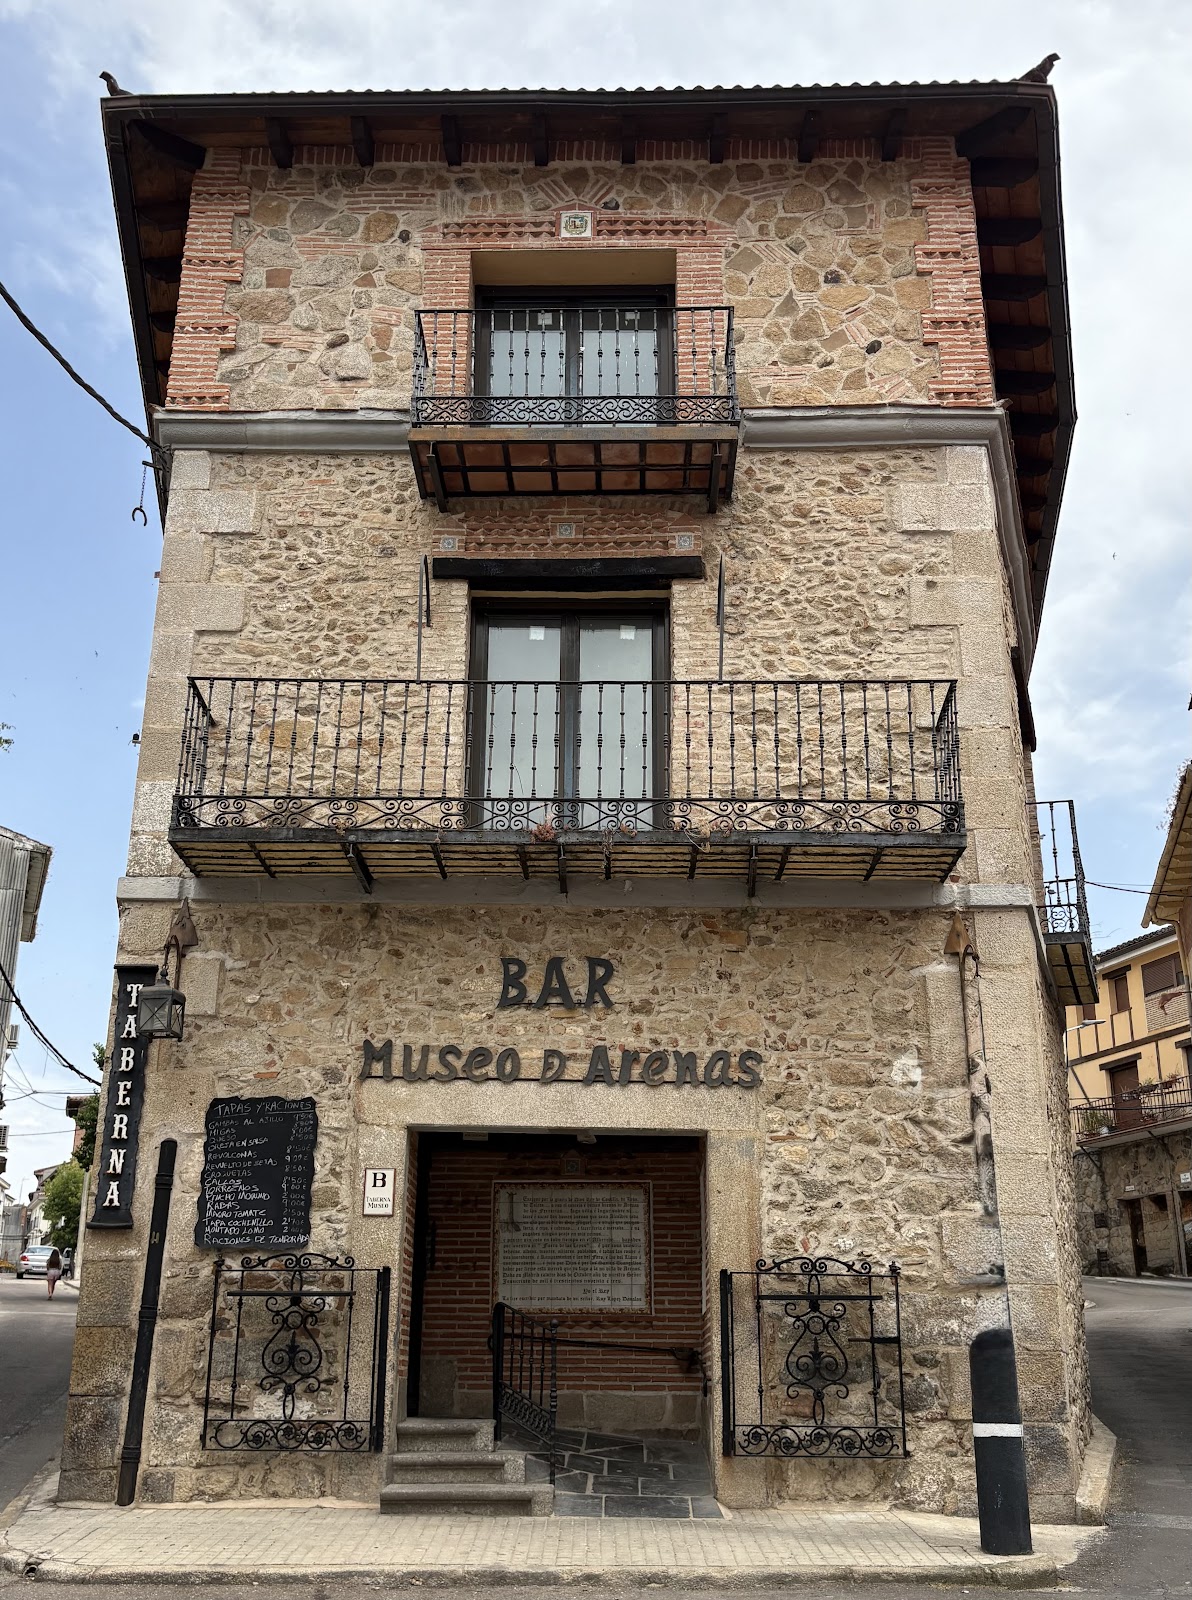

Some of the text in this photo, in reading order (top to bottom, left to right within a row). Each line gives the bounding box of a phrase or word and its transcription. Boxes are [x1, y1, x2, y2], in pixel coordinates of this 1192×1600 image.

[496, 956, 616, 1009] BAR
[583, 1045, 763, 1089] Arenas
[103, 983, 144, 1207] TABERNA
[214, 1103, 251, 1116] TAPAS
[264, 1101, 312, 1112] RACIONES
[236, 1138, 247, 1146] EN
[372, 1172, 387, 1187] B
[206, 1201, 240, 1210] RABAS
[233, 1210, 266, 1218] TOMATE
[203, 1217, 226, 1227] TAPA
[205, 1227, 240, 1235] MONTADO
[204, 1235, 251, 1245] RACIONES
[268, 1234, 310, 1244] TEMPORADA
